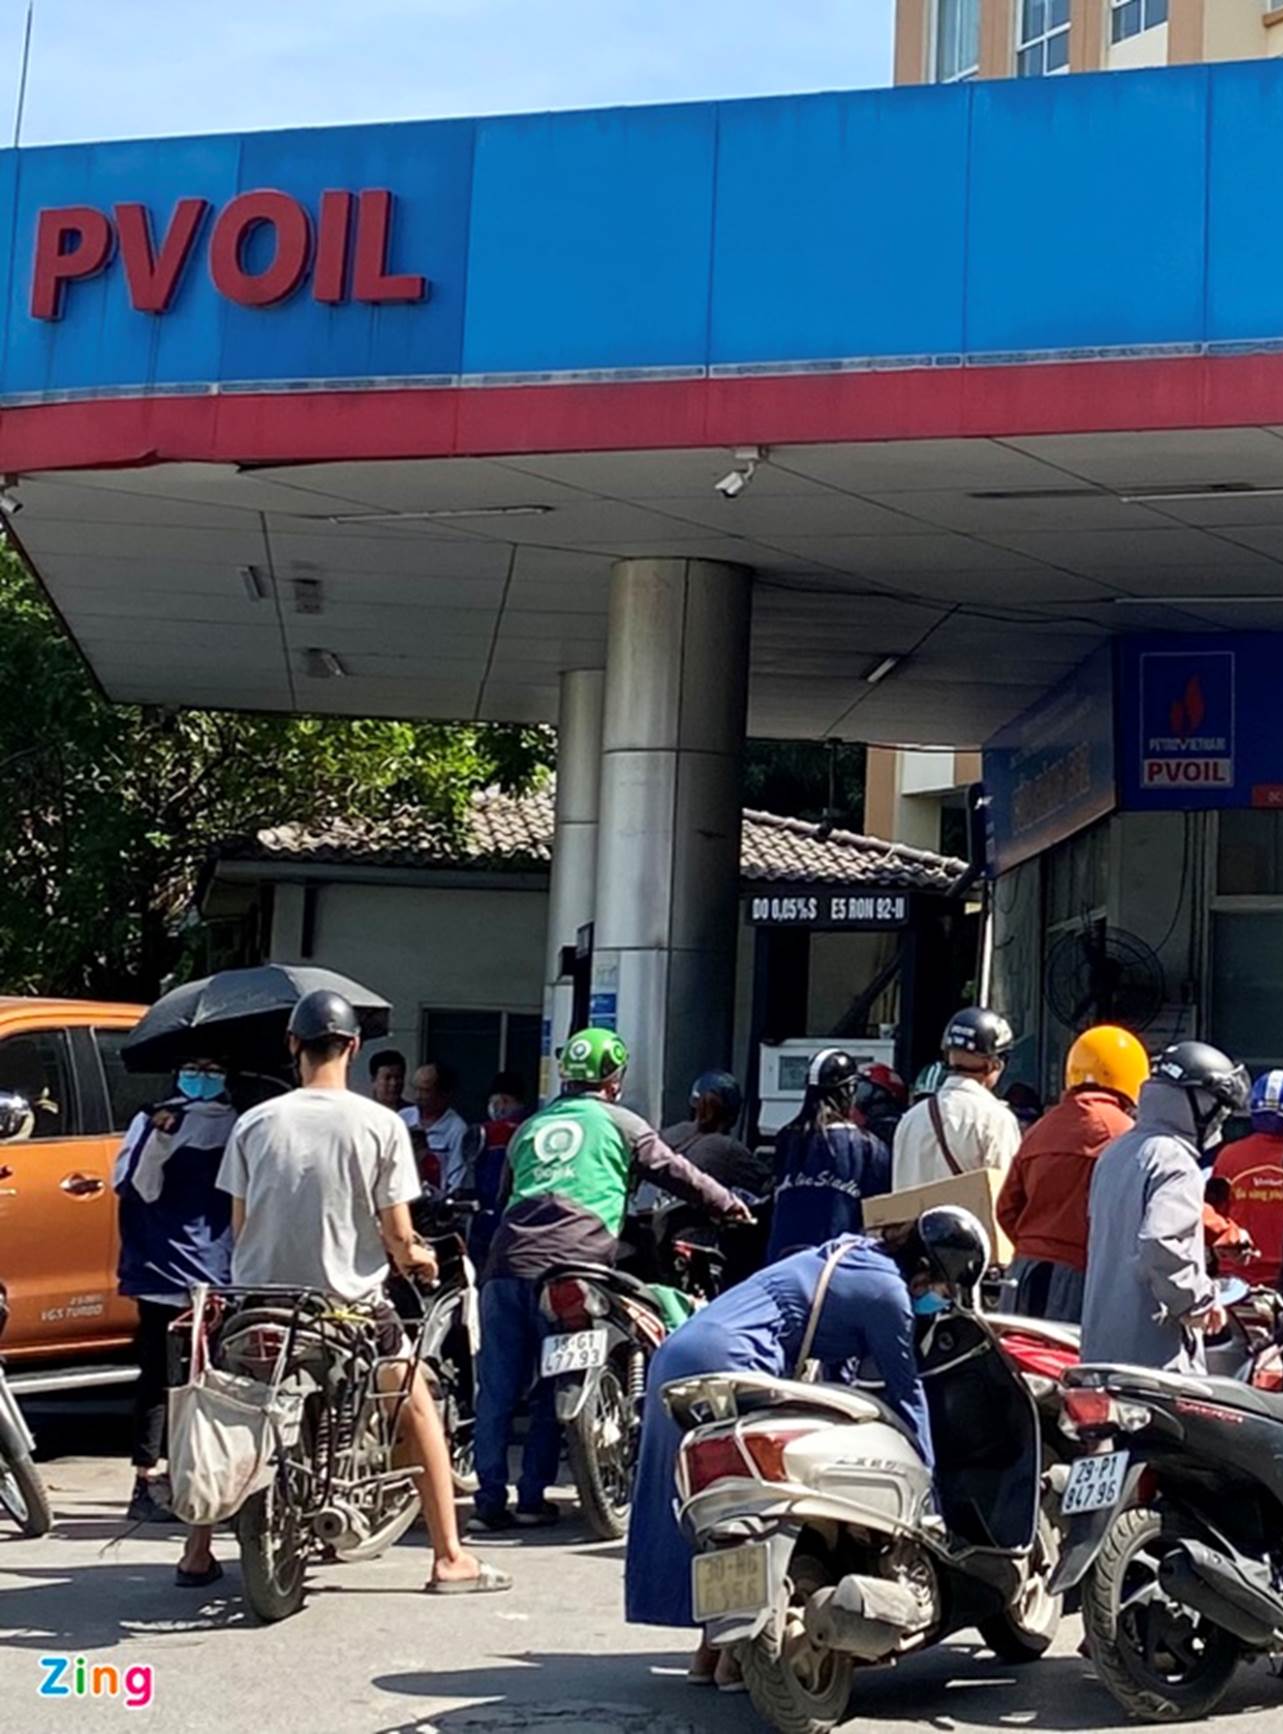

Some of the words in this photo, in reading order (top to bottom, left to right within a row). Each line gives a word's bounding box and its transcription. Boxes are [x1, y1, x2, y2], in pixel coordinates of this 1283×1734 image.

[29, 188, 429, 321] PVOIL
[1147, 761, 1226, 782] PVOIL
[830, 897, 846, 920] E5
[848, 897, 874, 920] RON
